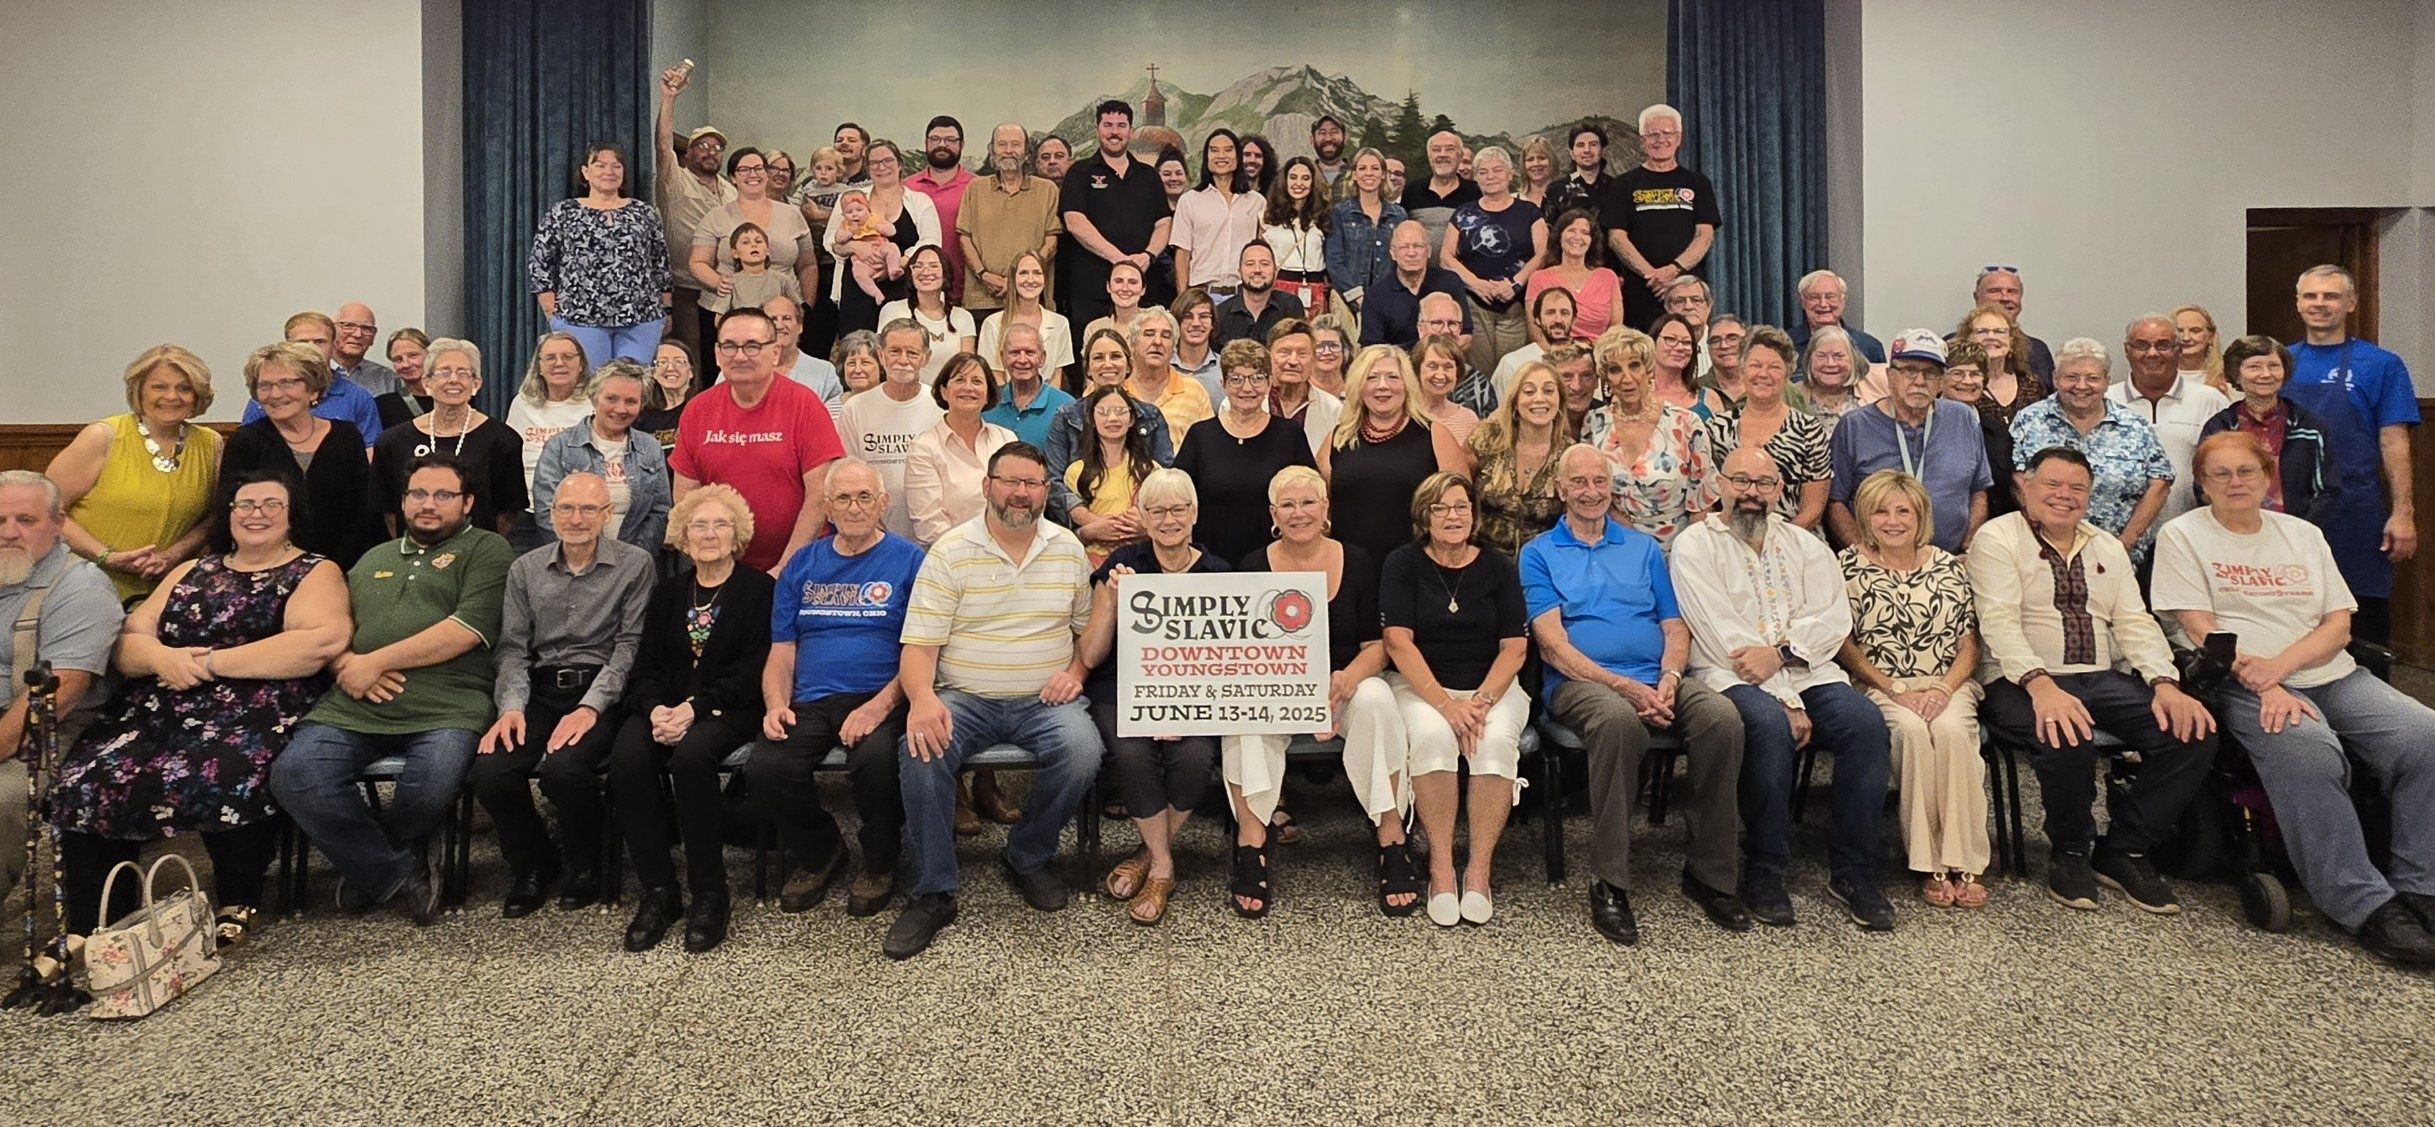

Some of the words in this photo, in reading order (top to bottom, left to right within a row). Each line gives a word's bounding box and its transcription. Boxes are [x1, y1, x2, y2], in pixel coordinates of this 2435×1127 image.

[703, 429, 727, 445] Jak
[748, 432, 783, 443] masz
[863, 433, 916, 452] SIMPLY
[878, 444, 910, 454] SLAV
[1130, 590, 1251, 635] SIMPLY
[1164, 618, 1270, 641] SLAVIC
[1141, 645, 1308, 662] DOWNTOWN
[1141, 662, 1308, 677] YOUNGSTOWN
[1134, 684, 1202, 699] FRIDAY
[1205, 684, 1218, 701] &
[1221, 683, 1318, 698] SATURDAY
[1130, 704, 1213, 722] JUNE
[1218, 705, 1275, 724] 13-14,
[1279, 706, 1327, 723] 2025
